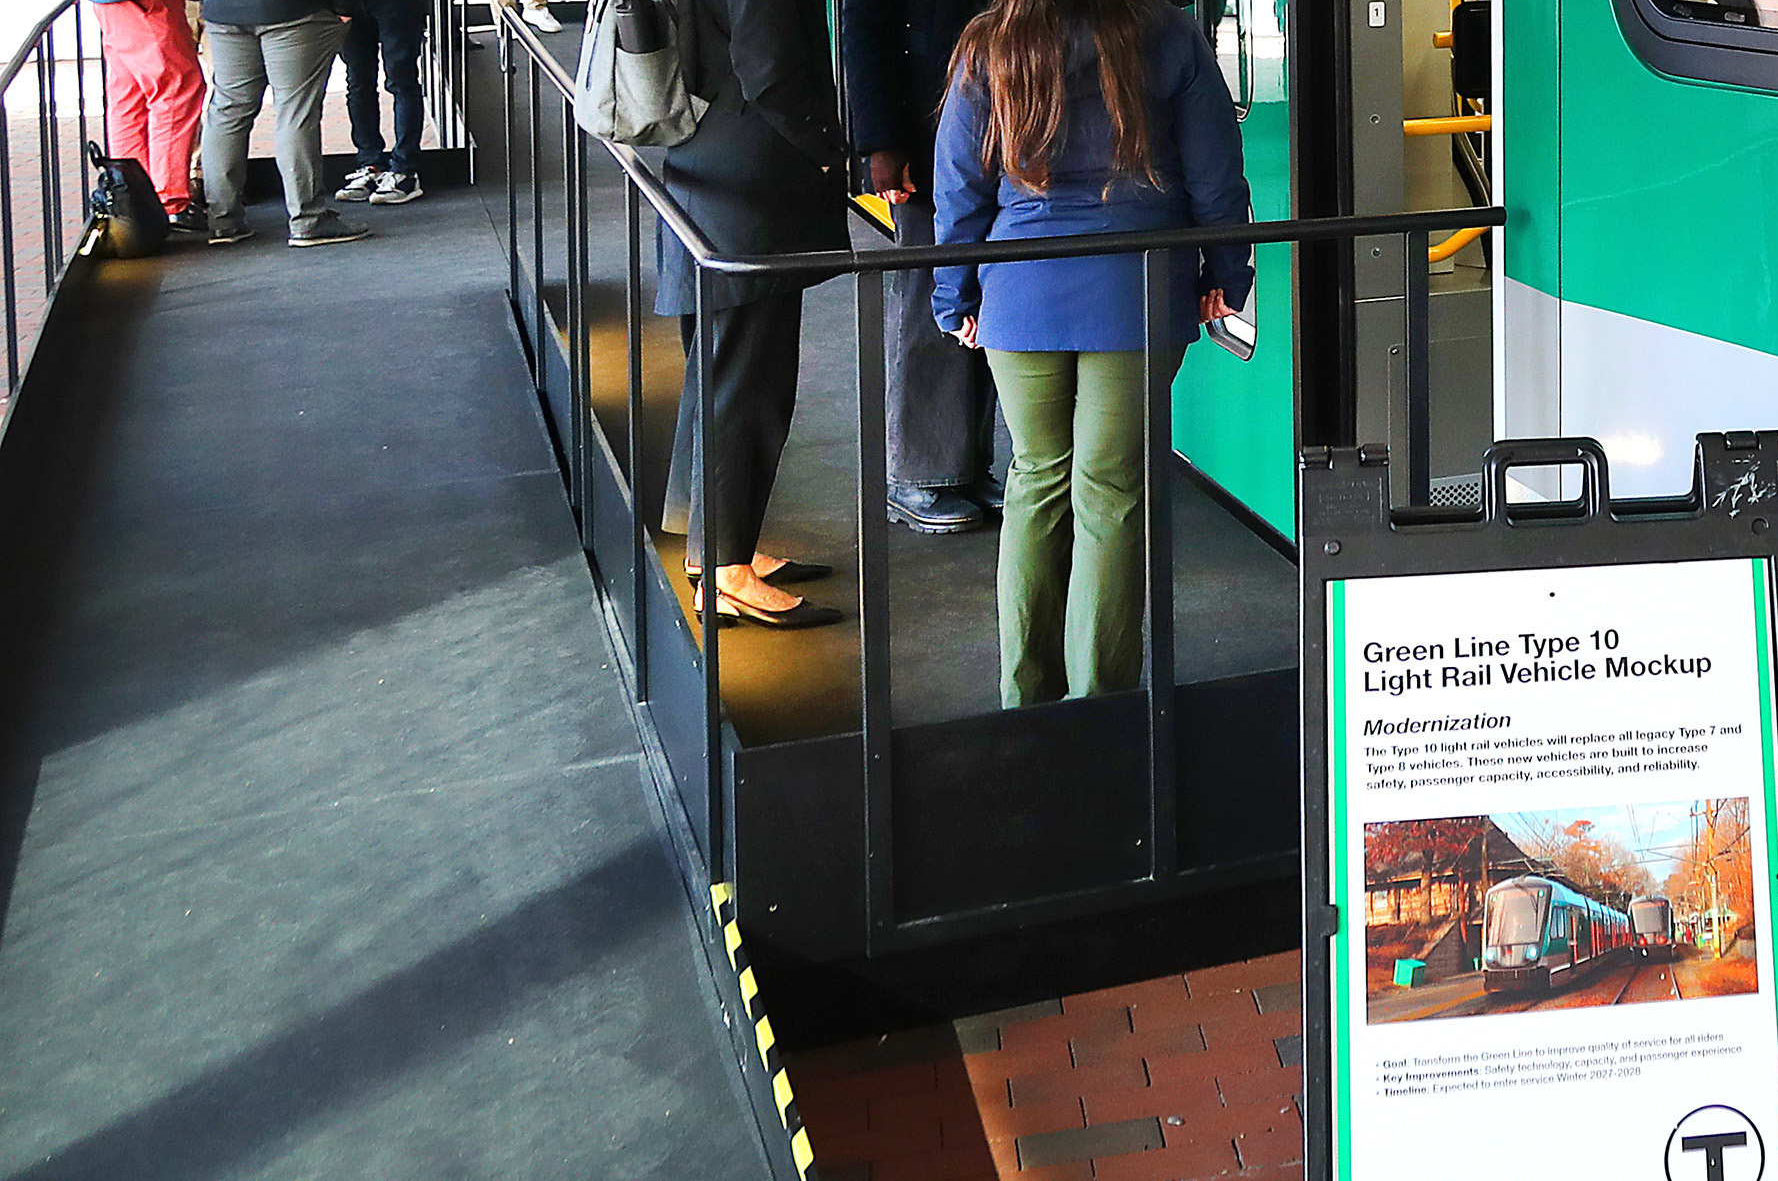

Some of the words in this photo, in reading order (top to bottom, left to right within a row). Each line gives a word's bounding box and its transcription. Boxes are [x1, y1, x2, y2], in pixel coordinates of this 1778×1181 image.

[1373, 7, 1380, 18] 1
[1363, 642, 1444, 663] Green
[1455, 636, 1510, 658] Line
[1518, 633, 1580, 659] Type
[1590, 629, 1619, 650] 10
[1364, 669, 1432, 696] Light
[1442, 664, 1491, 687] Rail
[1500, 659, 1596, 684] Vehicle
[1605, 654, 1712, 678] Mockup
[1363, 713, 1511, 736] Modernization
[1364, 747, 1387, 757] The
[1391, 745, 1419, 758] Type
[1424, 743, 1437, 753] 10
[1441, 741, 1467, 754] light
[1471, 740, 1490, 750] rail
[1493, 737, 1543, 749] vehicles
[1547, 735, 1567, 745] will
[1570, 733, 1615, 746] replace
[1619, 731, 1633, 741] all
[1636, 729, 1675, 742] legacy
[1678, 727, 1706, 739] Type
[1709, 725, 1716, 735] 7
[1720, 724, 1742, 735] and
[1366, 763, 1394, 775] Type
[1409, 759, 1463, 771] vehicles.
[1467, 756, 1504, 767] These
[1507, 754, 1533, 764] new
[1536, 750, 1586, 763] vehicles
[1589, 750, 1608, 759] are
[1612, 747, 1638, 758] built
[1642, 746, 1654, 756] to
[1657, 743, 1708, 755] increase
[1366, 778, 1407, 790] safety,
[1410, 775, 1475, 789] passenger
[1479, 770, 1533, 784] capacity,
[1536, 765, 1614, 779] accessibility,
[1617, 763, 1640, 774] and
[1643, 759, 1700, 772] reliability.
[1383, 1074, 1403, 1084] Key
[1406, 1068, 1482, 1082] Improvements:
[1485, 1063, 1515, 1075] Safety
[1518, 1059, 1572, 1072] technology,
[1575, 1055, 1617, 1067] capacity,
[1619, 1053, 1637, 1063] and
[1640, 1050, 1688, 1063] passenger
[1691, 1045, 1742, 1058] experience
[1413, 1055, 1461, 1067] Transform
[1463, 1053, 1478, 1062] the
[1481, 1050, 1510, 1061] Green
[1512, 1049, 1532, 1058] Line
[1535, 1047, 1545, 1056] to
[1547, 1045, 1585, 1056] improve
[1588, 1041, 1619, 1053] quality
[1621, 1040, 1631, 1049] of
[1634, 1038, 1667, 1048] service
[1669, 1036, 1682, 1045] for
[1685, 1034, 1696, 1044] all
[1697, 1032, 1724, 1043] riders
[1384, 1086, 1430, 1097] Timeline:
[1432, 1080, 1478, 1094] Expected
[1481, 1079, 1491, 1089] to
[1493, 1077, 1517, 1087] enter
[1520, 1074, 1554, 1086] service
[1557, 1071, 1587, 1083] Winter
[1682, 1131, 1747, 1181] T
